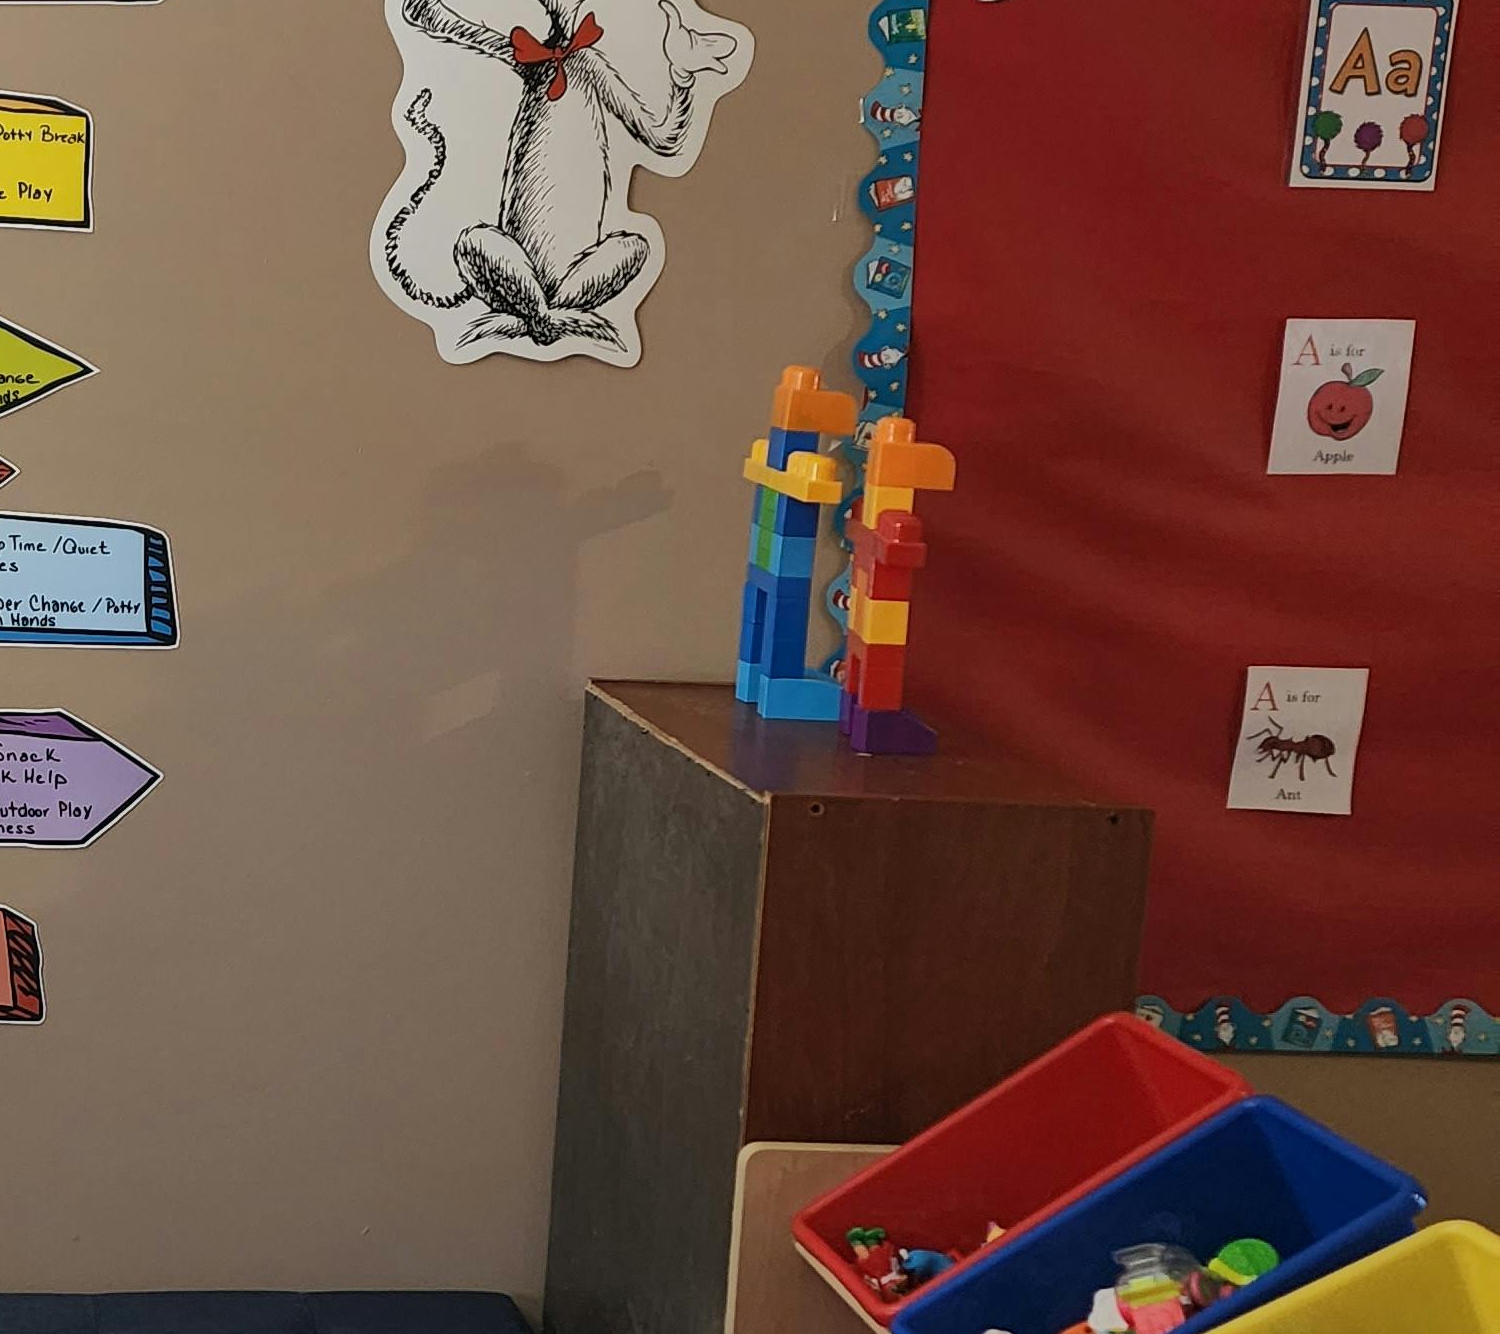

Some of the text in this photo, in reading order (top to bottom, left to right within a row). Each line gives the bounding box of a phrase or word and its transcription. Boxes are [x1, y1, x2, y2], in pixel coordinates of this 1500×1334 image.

[1328, 26, 1424, 98] Aa
[40, 124, 85, 144] Break
[18, 181, 53, 203] Play
[1291, 333, 1366, 366] A is for
[1312, 449, 1355, 464] Apple
[8, 534, 47, 552] Time
[106, 597, 141, 615] Potty
[1250, 680, 1322, 711] A is for
[24, 768, 68, 790] Help
[1275, 787, 1302, 801] Ant
[58, 800, 93, 820] Play
